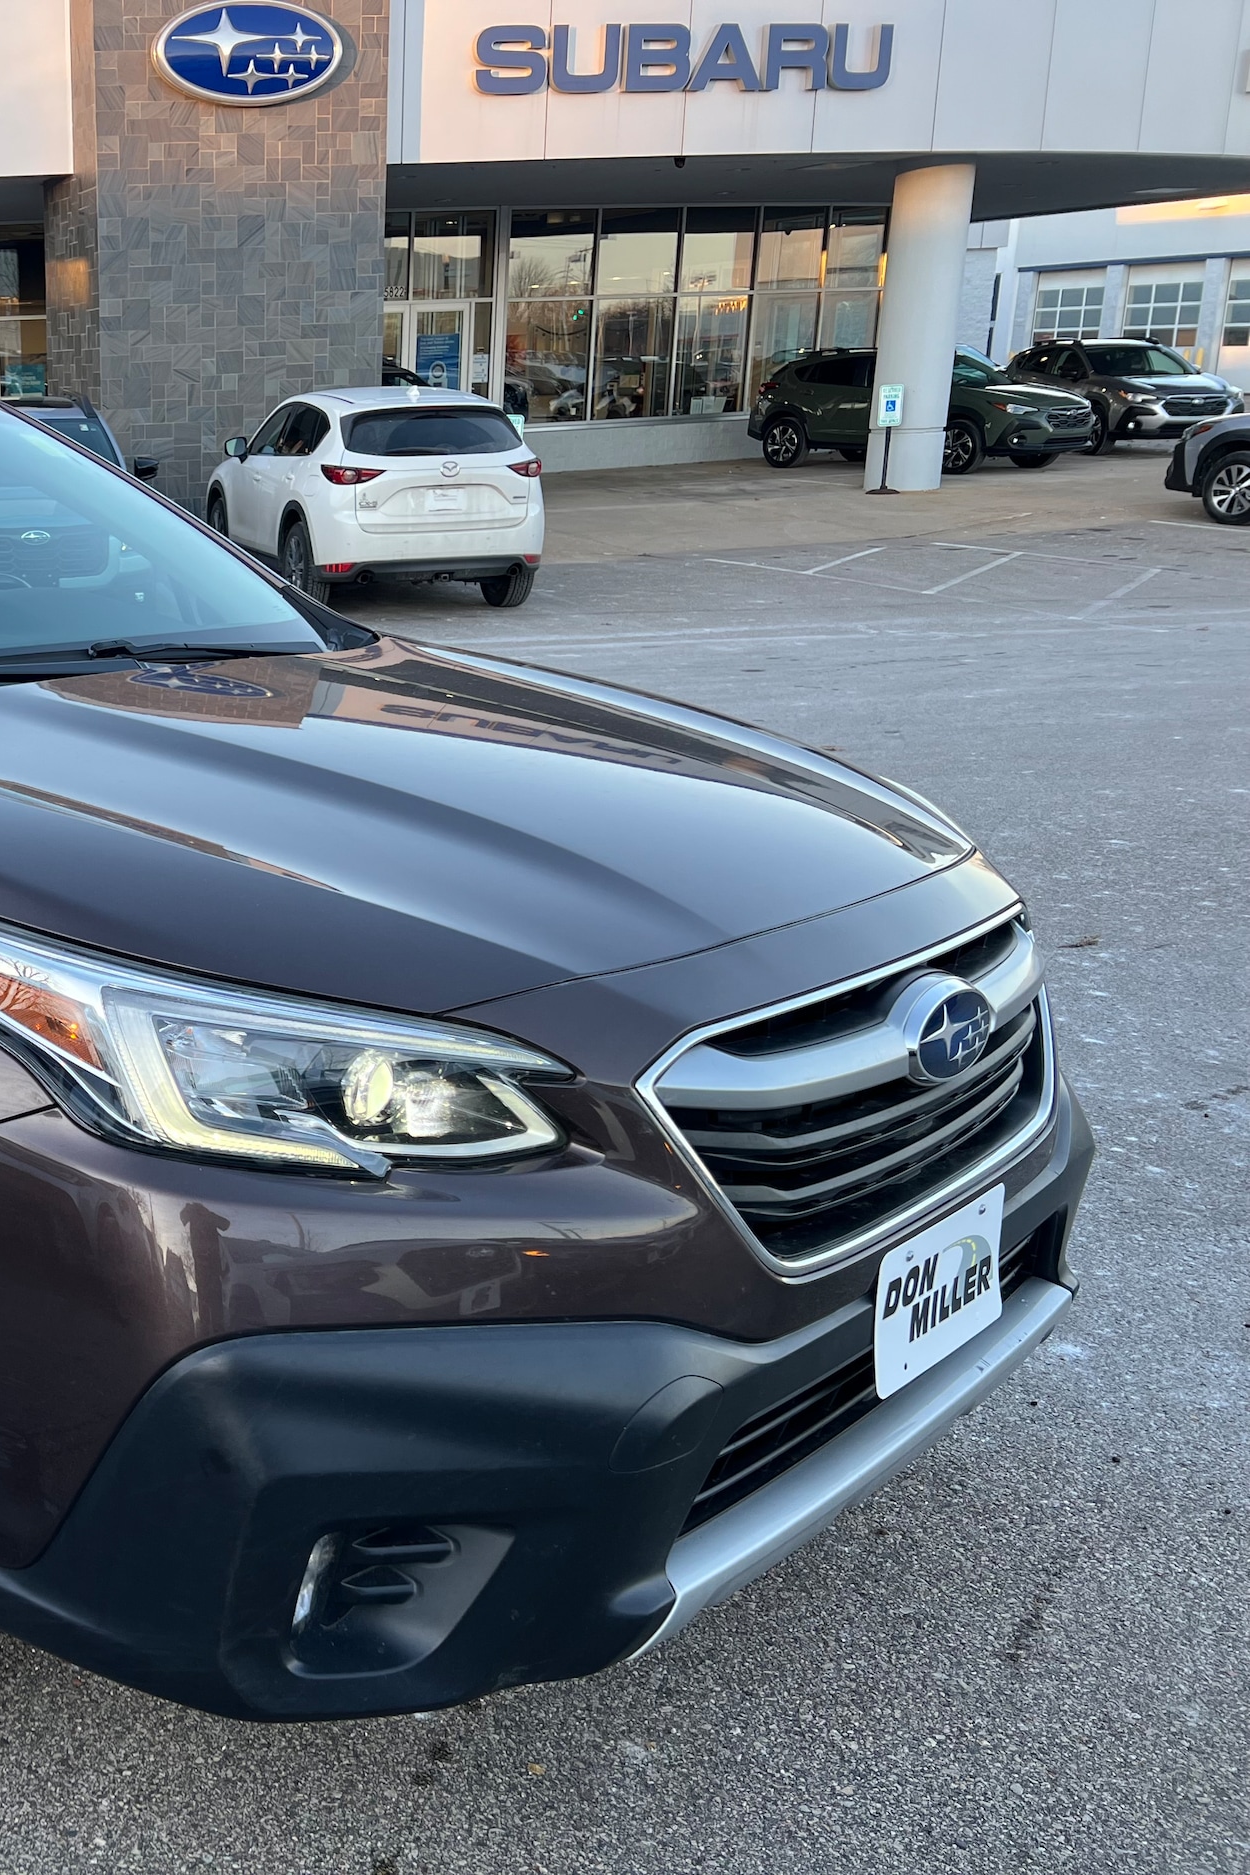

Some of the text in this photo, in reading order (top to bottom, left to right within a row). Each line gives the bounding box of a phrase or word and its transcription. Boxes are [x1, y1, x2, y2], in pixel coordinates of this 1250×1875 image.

[473, 23, 895, 95] SUBARU
[383, 286, 405, 298] 5822
[882, 1252, 939, 1320] DON
[908, 1255, 991, 1344] MILLER
